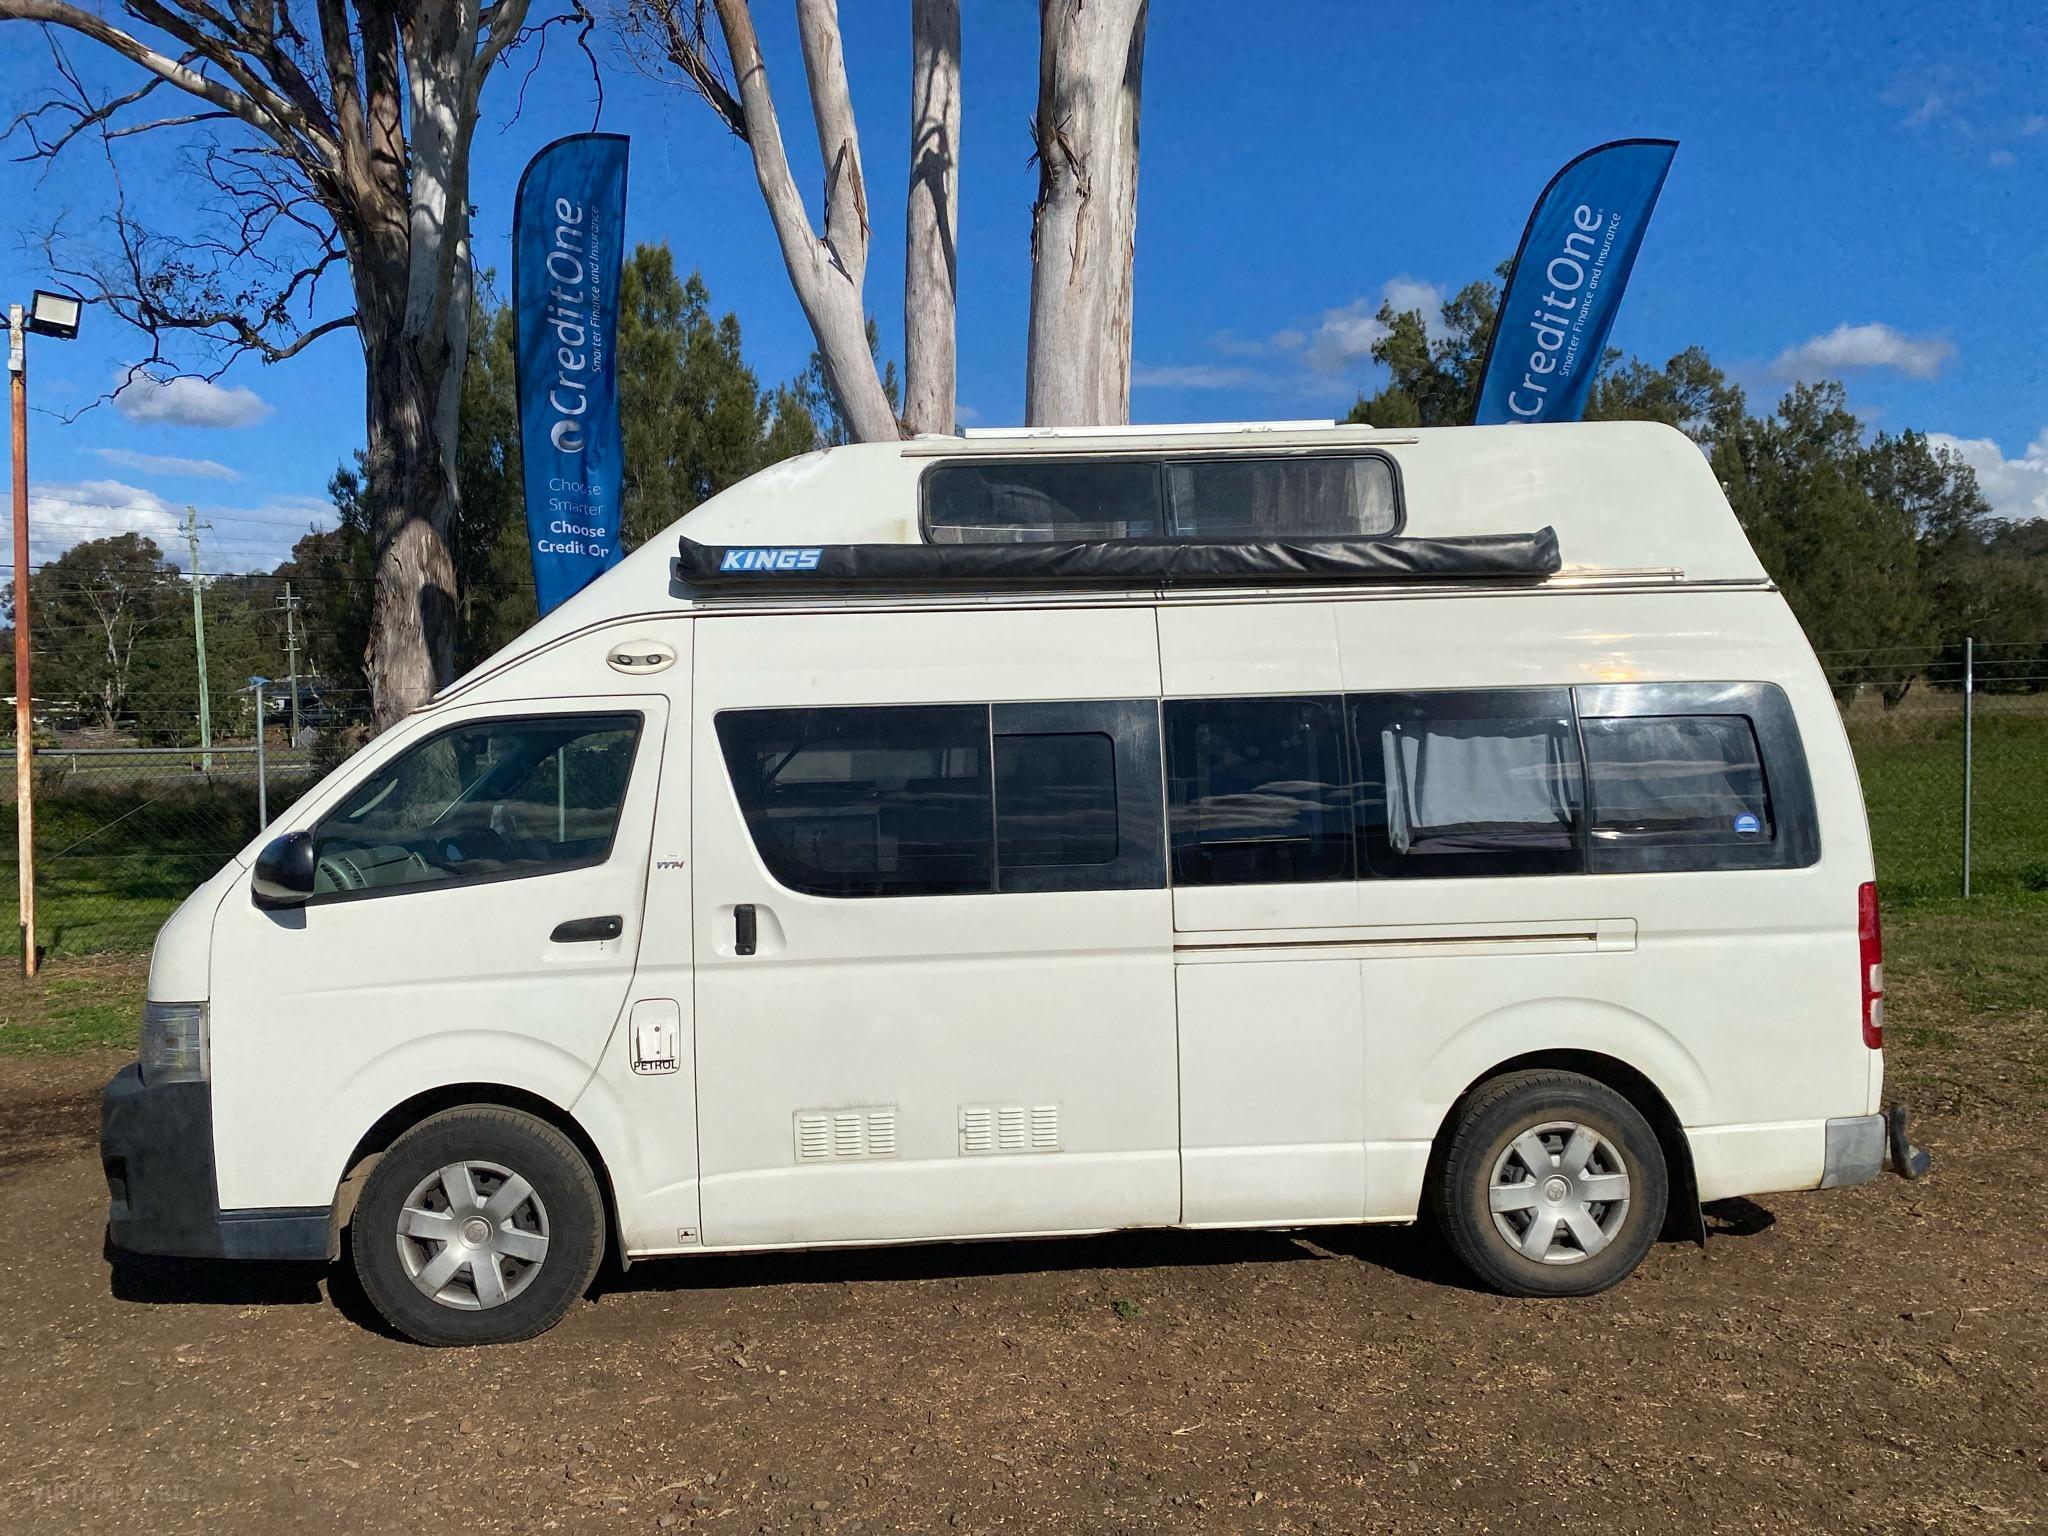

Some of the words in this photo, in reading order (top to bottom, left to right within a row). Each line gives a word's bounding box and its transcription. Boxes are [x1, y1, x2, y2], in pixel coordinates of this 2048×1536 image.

[589, 205, 599, 261] Insurance
[1595, 213, 1621, 267] Insurance
[589, 262, 600, 284] and
[1589, 268, 1602, 289] and
[547, 197, 587, 415] CreditOne
[590, 286, 601, 327] Finance
[1508, 204, 1603, 416] CreditOne
[1573, 291, 1594, 333] Finance
[592, 331, 602, 373] Smarter
[1559, 333, 1580, 377] Smarter
[549, 477, 601, 496] Choose
[549, 498, 604, 516] Smarter
[550, 520, 606, 538] Choose
[537, 540, 586, 555] Credit
[721, 550, 820, 570] KINGS
[633, 1059, 678, 1071] PETROL
